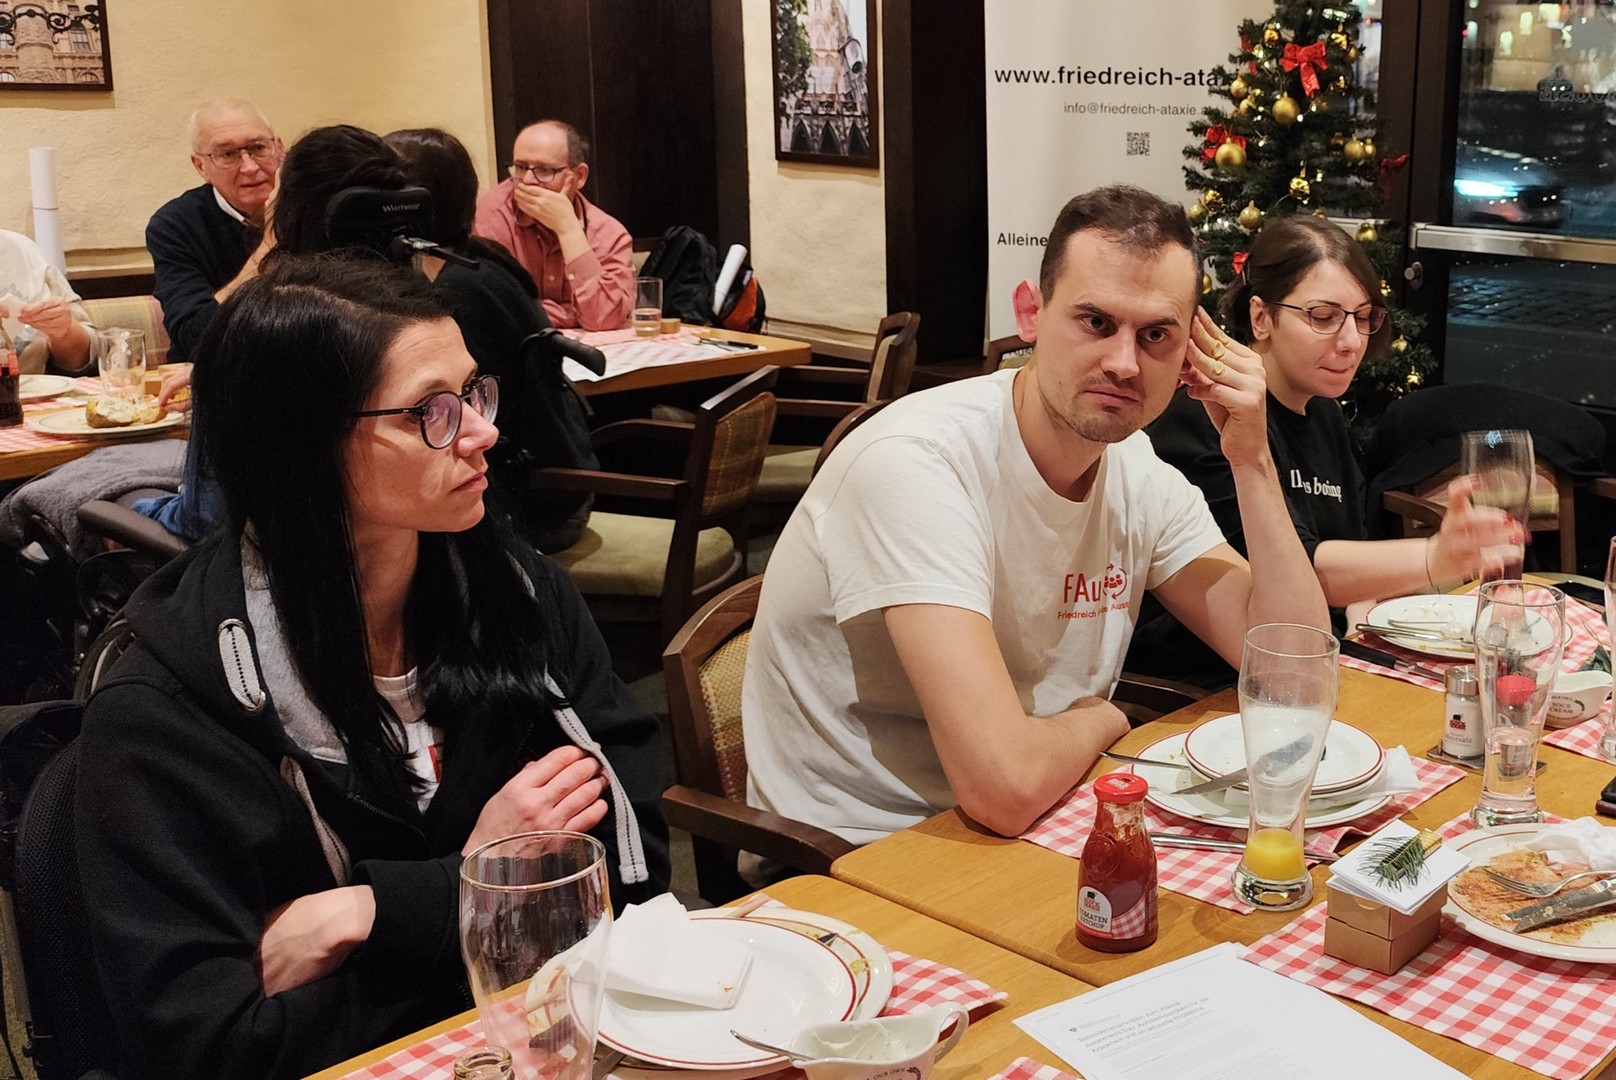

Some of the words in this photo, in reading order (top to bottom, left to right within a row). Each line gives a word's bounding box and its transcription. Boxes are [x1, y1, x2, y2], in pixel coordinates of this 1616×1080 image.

[994, 66, 1220, 86] www.friedreich-ata
[1063, 102, 1209, 116] info@friedreich-ataxie.a
[997, 232, 1048, 247] Alleine
[1111, 601, 1129, 611] Aust
